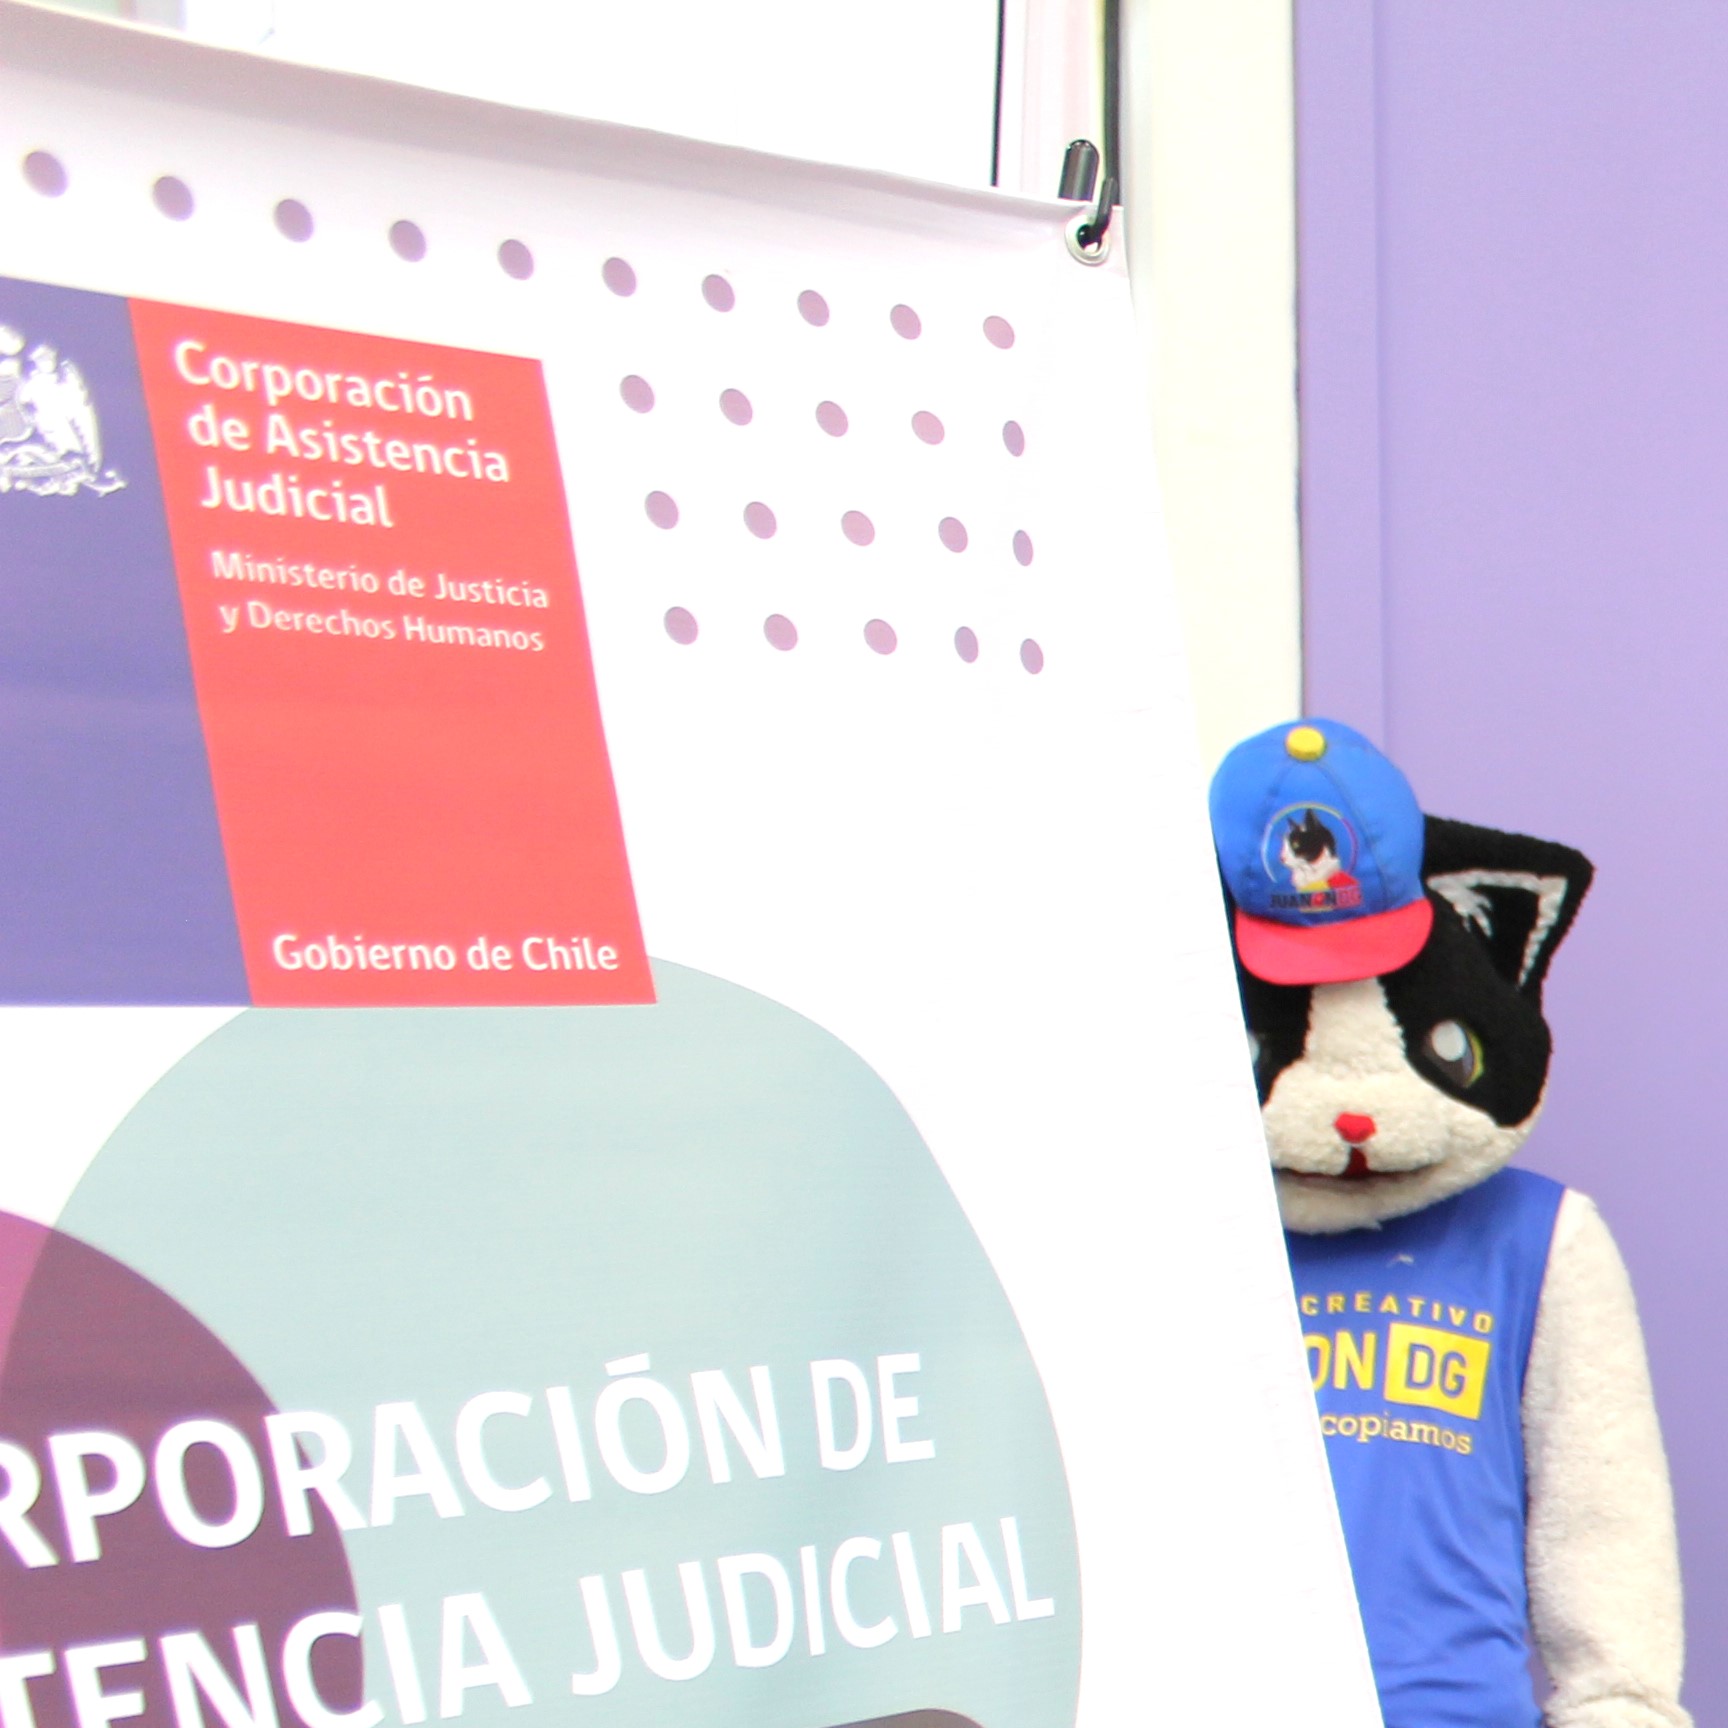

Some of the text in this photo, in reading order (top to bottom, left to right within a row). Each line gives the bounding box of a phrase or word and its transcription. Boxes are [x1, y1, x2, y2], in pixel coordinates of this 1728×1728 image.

[173, 339, 474, 421] Corporación
[186, 403, 510, 483] de Asistencia
[200, 466, 395, 528] Judicial
[211, 550, 550, 609] Ministerio de Justicia
[219, 600, 545, 652] y Derechos Humanos
[272, 933, 621, 973] Gobierno de Chile
[1301, 1292, 1494, 1334] CREATIVO
[811, 1352, 937, 1471] DE
[1320, 1410, 1474, 1456] copiamos
[572, 1516, 1057, 1697] JUDICIAL
